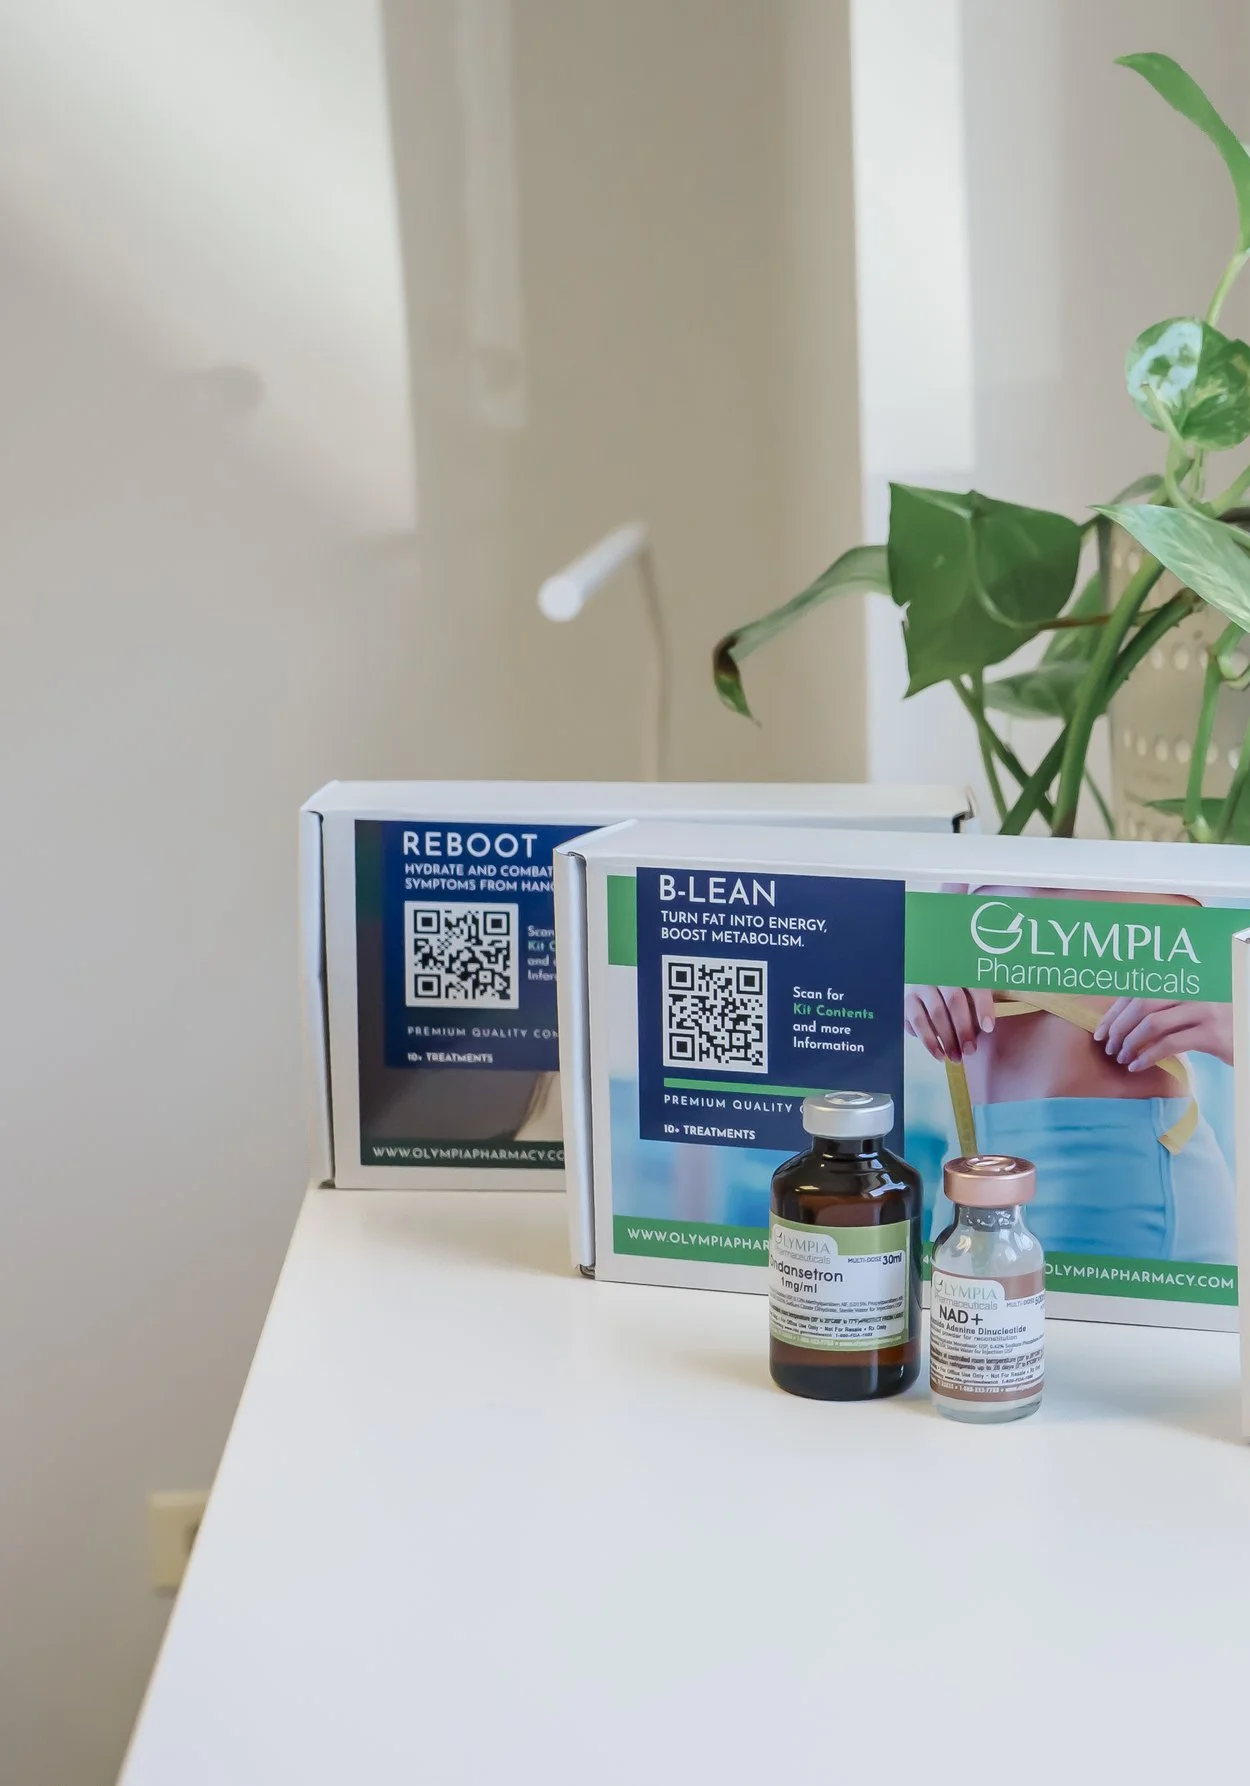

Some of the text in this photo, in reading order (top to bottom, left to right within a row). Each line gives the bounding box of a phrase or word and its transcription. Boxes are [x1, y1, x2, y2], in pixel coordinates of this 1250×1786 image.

[403, 831, 538, 858] REBOOT
[405, 863, 464, 877] HYDRATE
[468, 864, 496, 877] AND
[405, 878, 476, 891] SYMPTOMS
[480, 879, 517, 892] FROM
[659, 874, 776, 907] B-LEAN
[661, 910, 827, 933] TURN FAT INTO ENERGY,
[661, 928, 805, 947] BOOST METABOLISM.
[528, 940, 544, 951] Kit
[527, 954, 549, 966] and
[977, 957, 1200, 995] Pharmaceuticals
[793, 987, 845, 1001] Scan for
[793, 1003, 874, 1020] Kit Contents
[407, 1025, 466, 1037] PREMIUM
[472, 1027, 528, 1039] QUALITY
[793, 1021, 851, 1035] and more
[793, 1036, 864, 1052] Information
[426, 1052, 493, 1064] TREATMENTS
[664, 1094, 726, 1109] PREMIUM
[732, 1100, 793, 1113] QUALITY
[664, 1124, 756, 1140] 10+ TREATMENTS
[882, 1253, 902, 1265] 30ml
[781, 1277, 817, 1293] 1mg/ml
[946, 1324, 975, 1334] Adenine
[979, 1325, 1027, 1335] Dinucleotide
